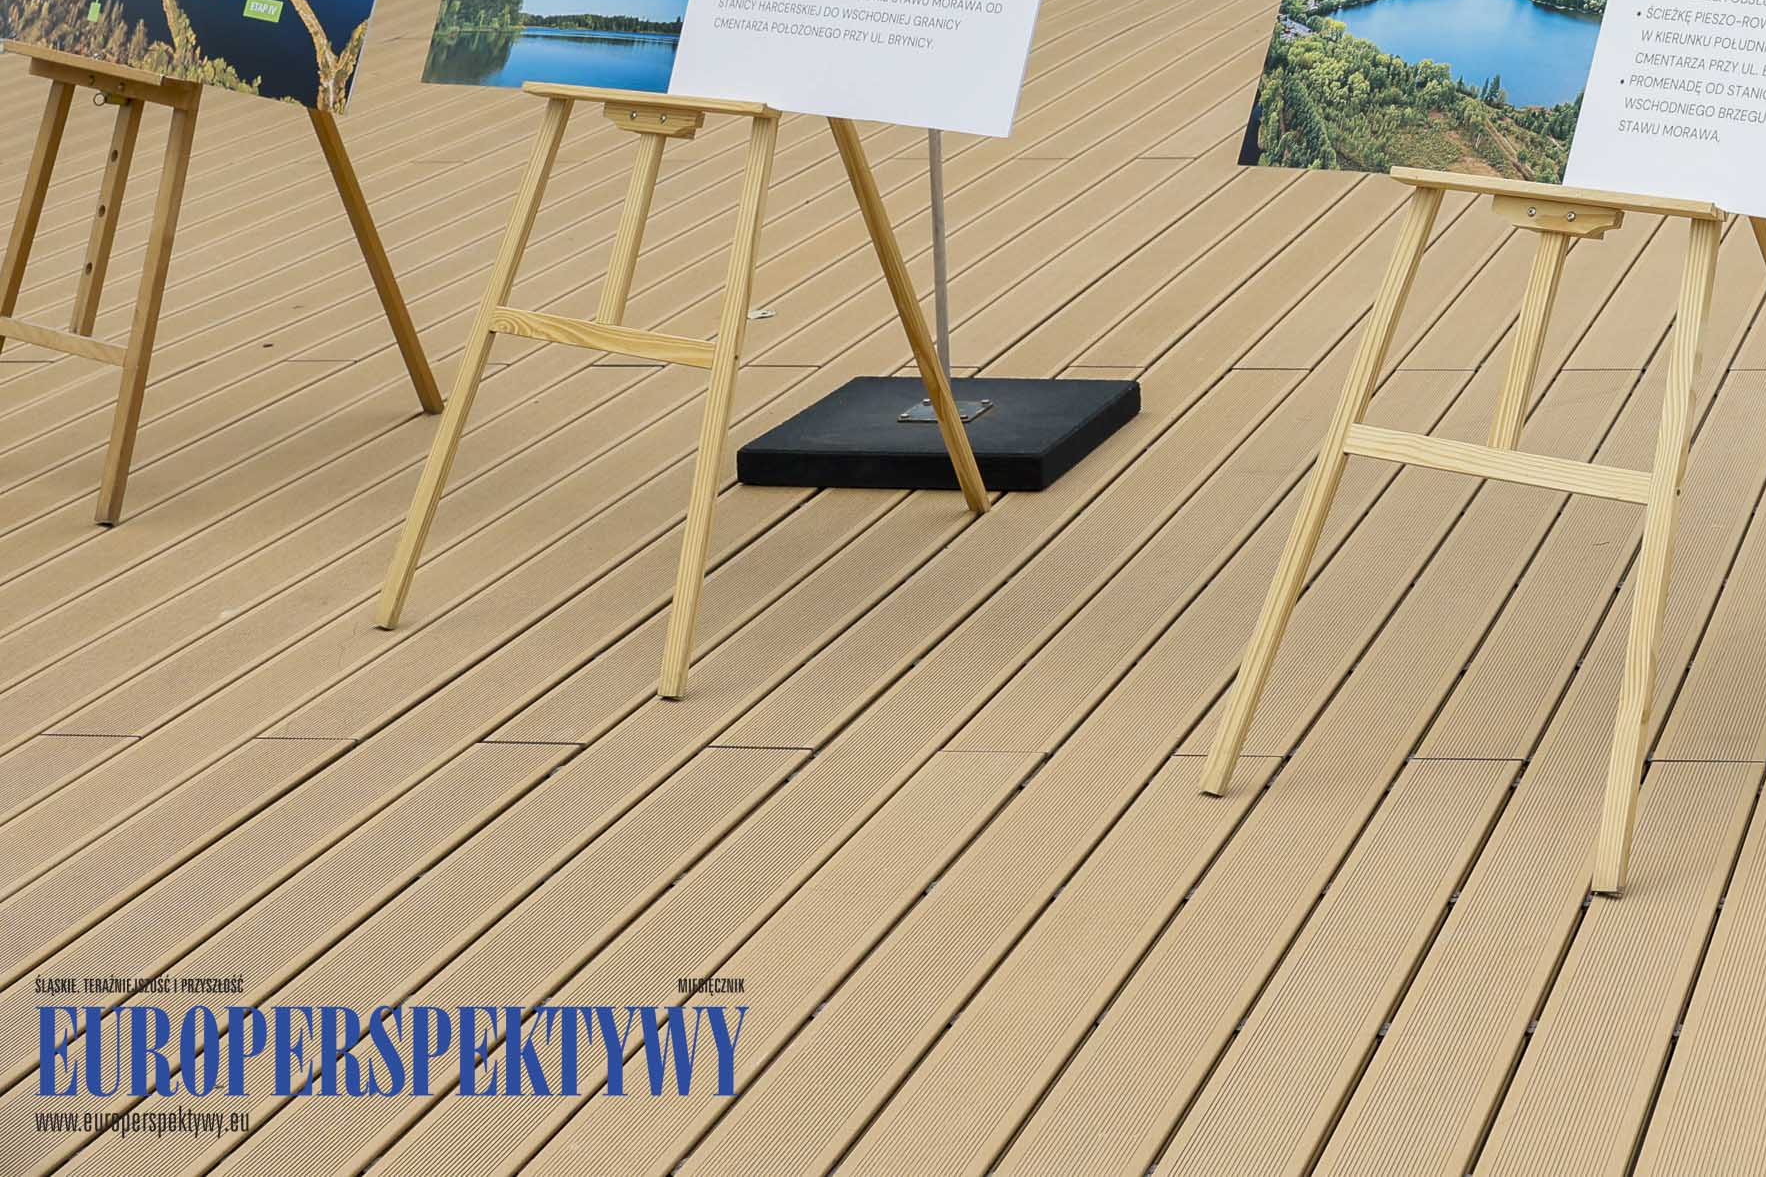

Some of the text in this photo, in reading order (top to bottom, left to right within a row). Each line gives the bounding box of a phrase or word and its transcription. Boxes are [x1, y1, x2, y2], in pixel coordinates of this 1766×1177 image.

[1645, 5, 1692, 25] ŚCIEŻKĘ
[1641, 29, 1653, 41] W
[1654, 29, 1712, 46] KIERUNKU
[1634, 51, 1705, 70] CMENTARZA
[1708, 58, 1739, 73] PRZY
[1628, 74, 1703, 95] PROMENADĘ
[1705, 81, 1724, 94] OD
[1624, 96, 1715, 117] WSCHODNIEGO
[1717, 106, 1766, 123] BRZEGU
[1617, 119, 1660, 134] STAWU
